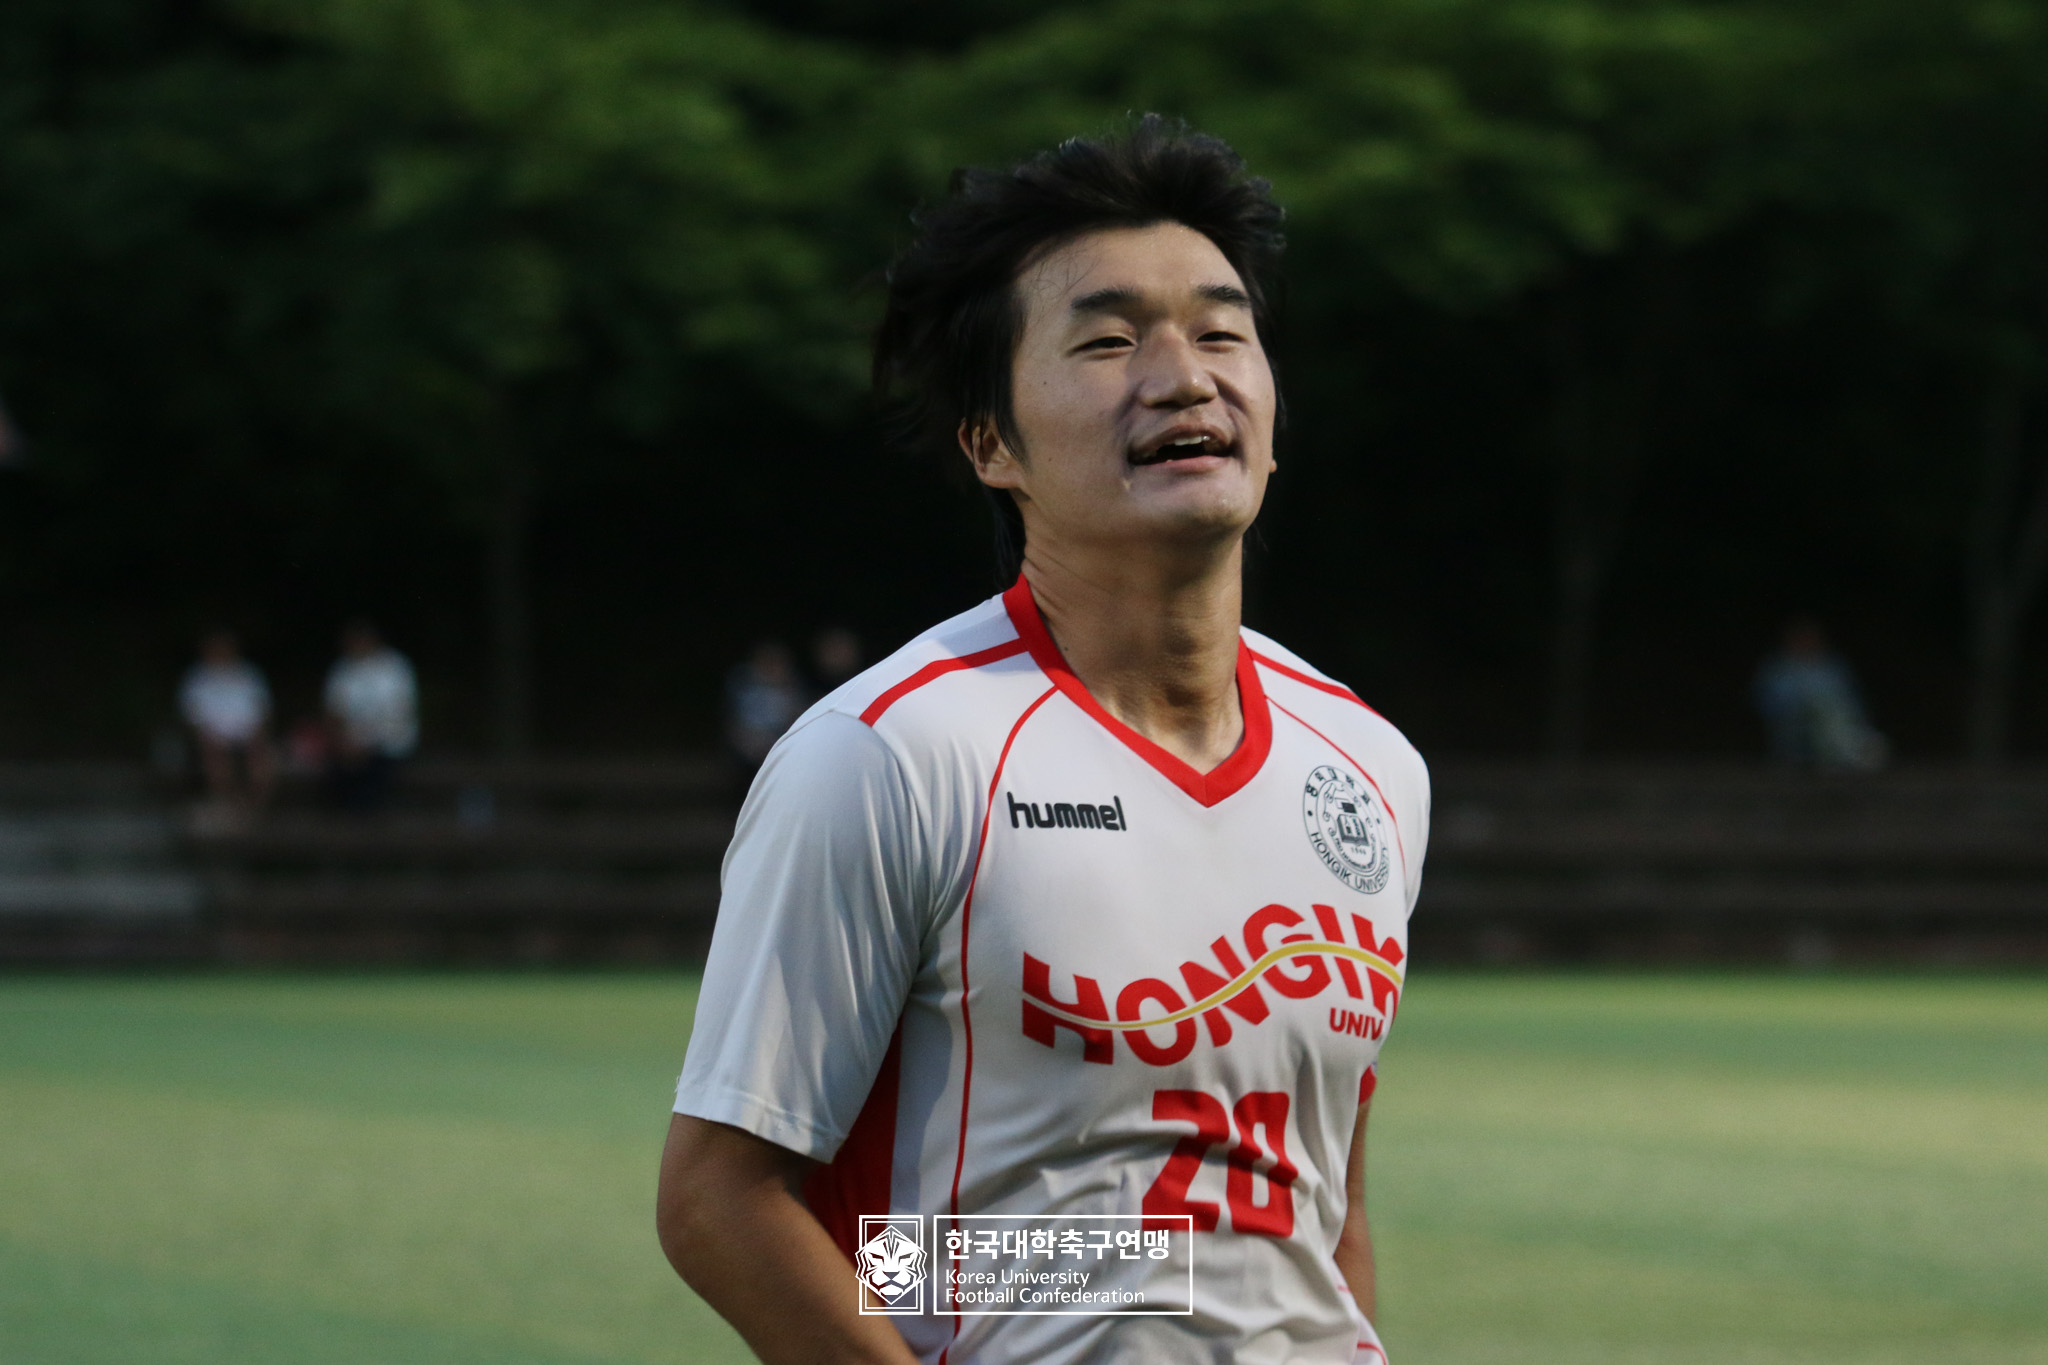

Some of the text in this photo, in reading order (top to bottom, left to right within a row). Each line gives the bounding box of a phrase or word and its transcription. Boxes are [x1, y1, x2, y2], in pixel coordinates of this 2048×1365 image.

[1007, 791, 1127, 832] hummel
[1308, 831, 1352, 886] HONGIK
[1022, 903, 1405, 1067] HONGIK
[1142, 1089, 1299, 1237] 20
